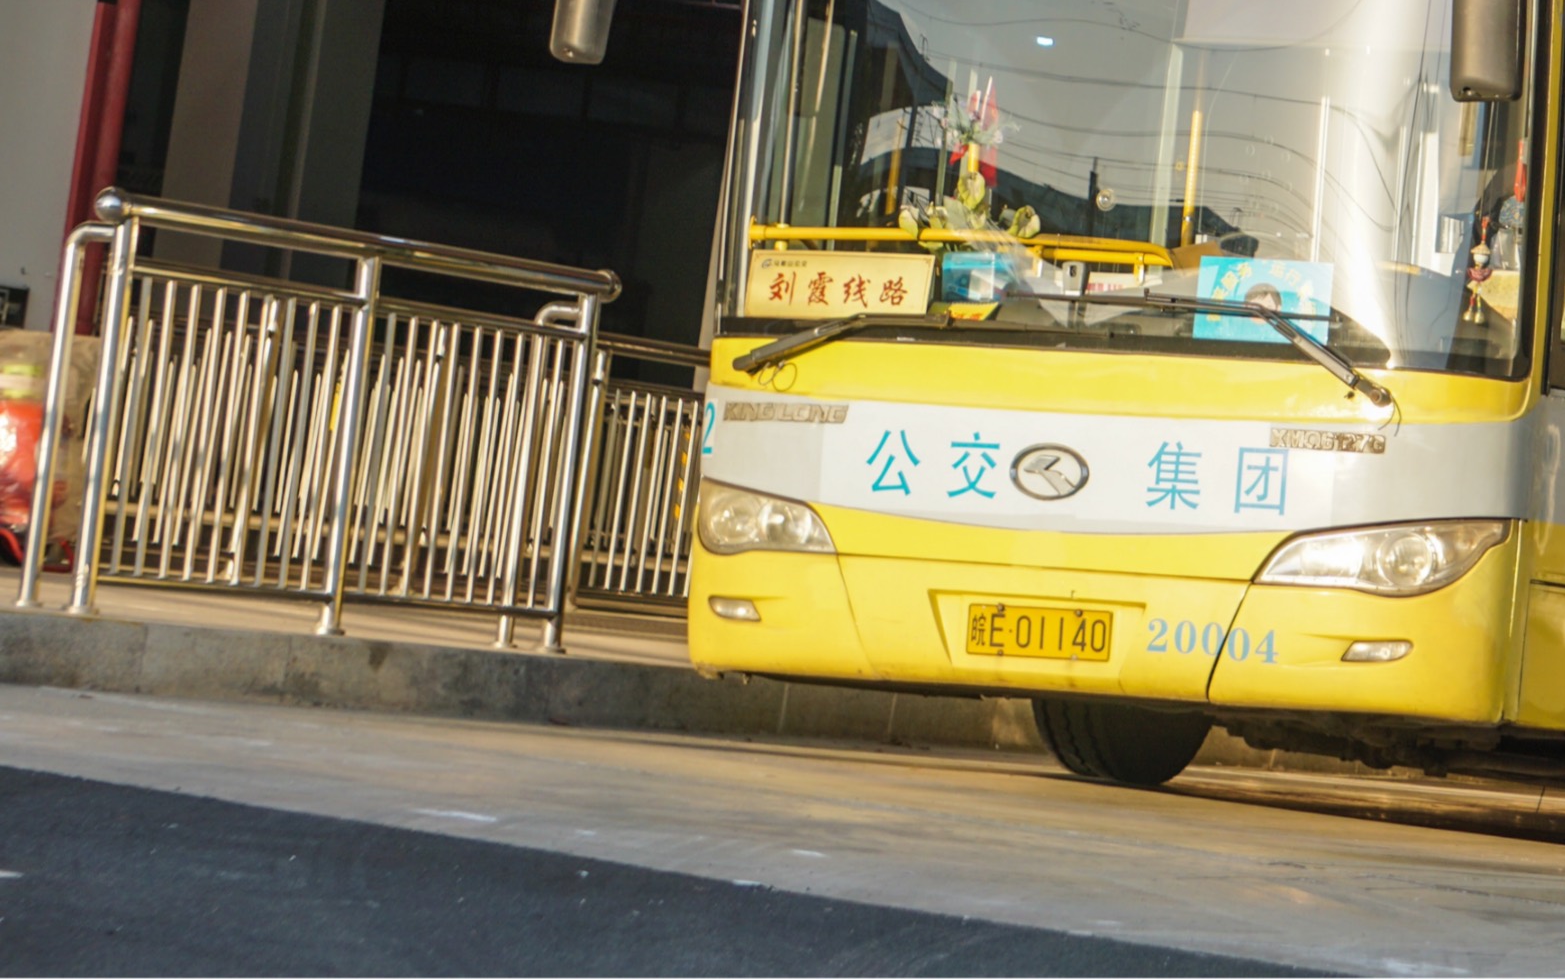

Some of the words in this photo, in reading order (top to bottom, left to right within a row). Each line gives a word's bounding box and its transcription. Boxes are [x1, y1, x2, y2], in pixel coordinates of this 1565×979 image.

[768, 270, 909, 309] 刘霞线路
[866, 430, 1001, 499] 公交
[1146, 440, 1290, 516] 集团
[1146, 618, 1280, 665] 20004
